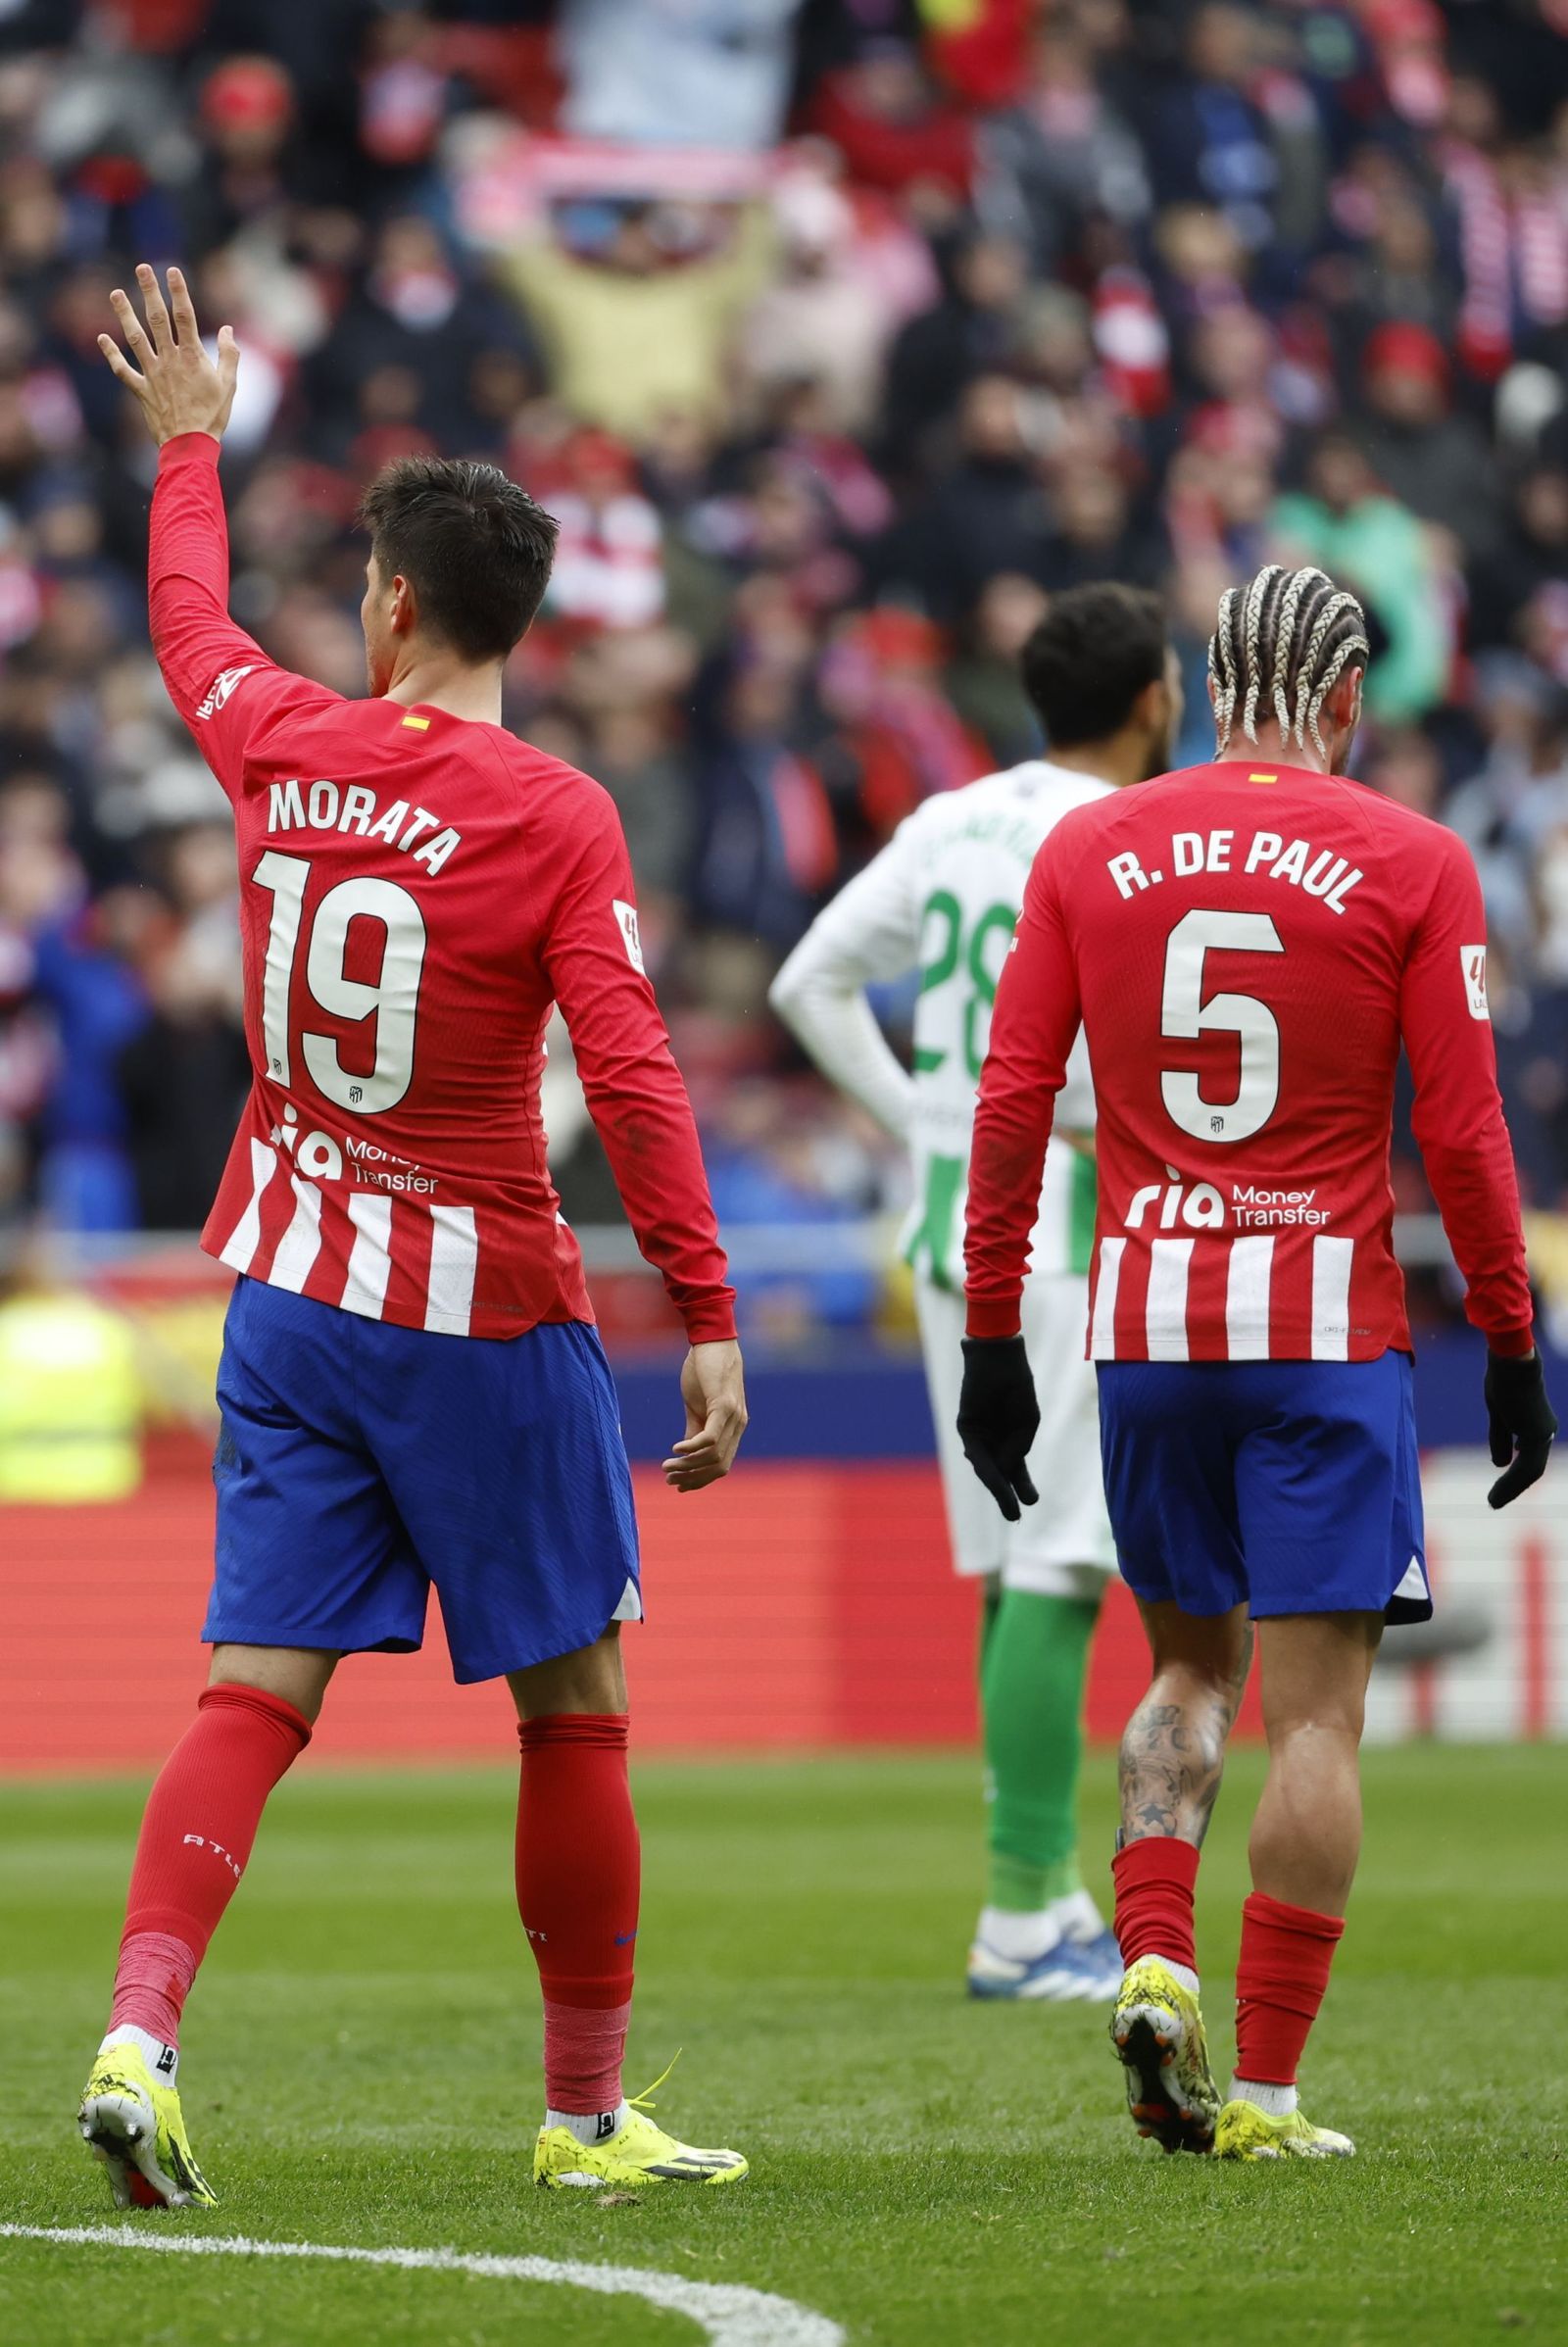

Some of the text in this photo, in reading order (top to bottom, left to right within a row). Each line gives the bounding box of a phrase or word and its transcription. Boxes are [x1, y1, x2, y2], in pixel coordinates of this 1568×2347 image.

[268, 780, 462, 877] MORATA
[1106, 830, 1363, 915] R. DE PAUL
[251, 850, 427, 1115] 19
[1159, 907, 1285, 1144] 5
[351, 1162, 439, 1195] Transfer
[1124, 1163, 1225, 1228] ria
[1232, 1184, 1316, 1204] Money
[1232, 1204, 1331, 1227] Transfer
